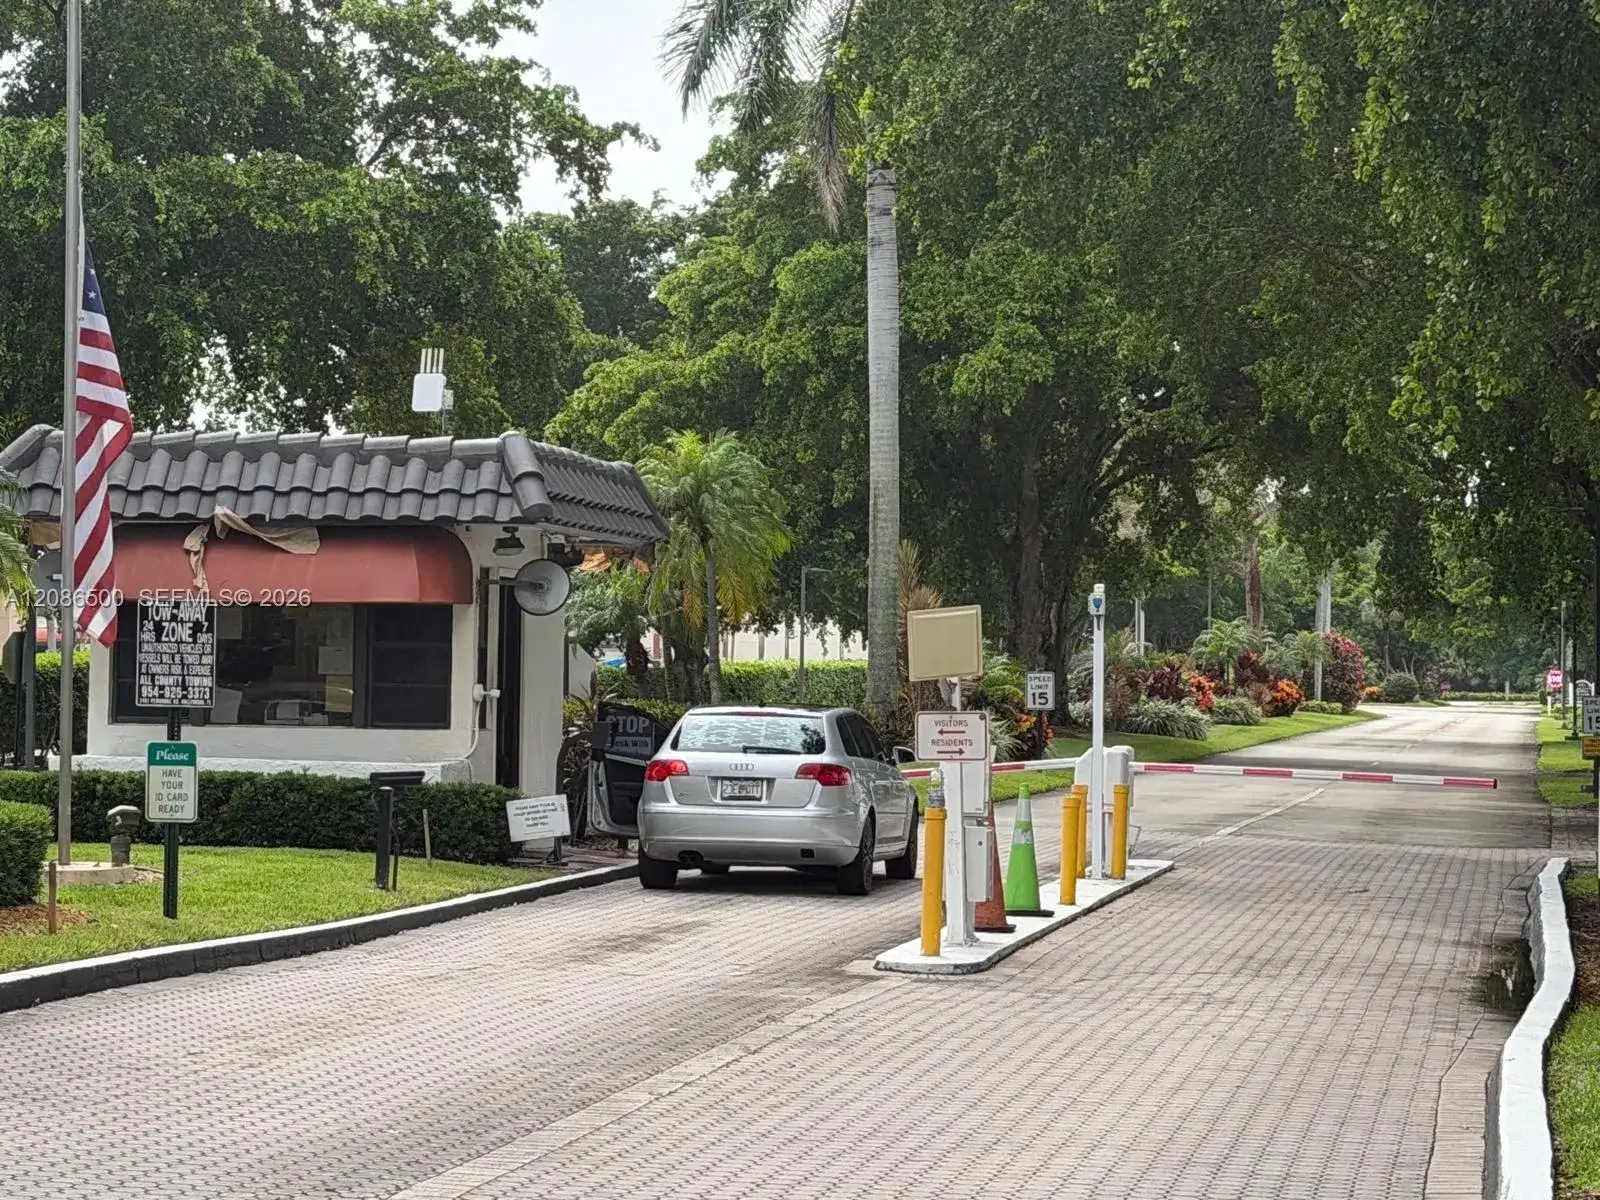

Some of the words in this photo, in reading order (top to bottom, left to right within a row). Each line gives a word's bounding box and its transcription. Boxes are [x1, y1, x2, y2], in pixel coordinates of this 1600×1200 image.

[142, 620, 154, 631] 24
[202, 621, 209, 632] 7
[140, 632, 156, 642] HRS
[161, 622, 193, 642] ZONE
[197, 633, 213, 644] DAYS
[174, 654, 182, 664] BE
[139, 675, 152, 685] ALL
[155, 675, 183, 686] COUNTY
[185, 676, 213, 687] TOWING
[1031, 692, 1049, 706] 15
[934, 719, 969, 728] VISITORS
[931, 738, 974, 747] RESIDENTS
[155, 748, 190, 761] Please
[161, 768, 183, 778] HAVE
[160, 781, 184, 790] YOUR
[155, 792, 164, 801] ID
[166, 792, 189, 801] CARD
[158, 804, 185, 814] READY
